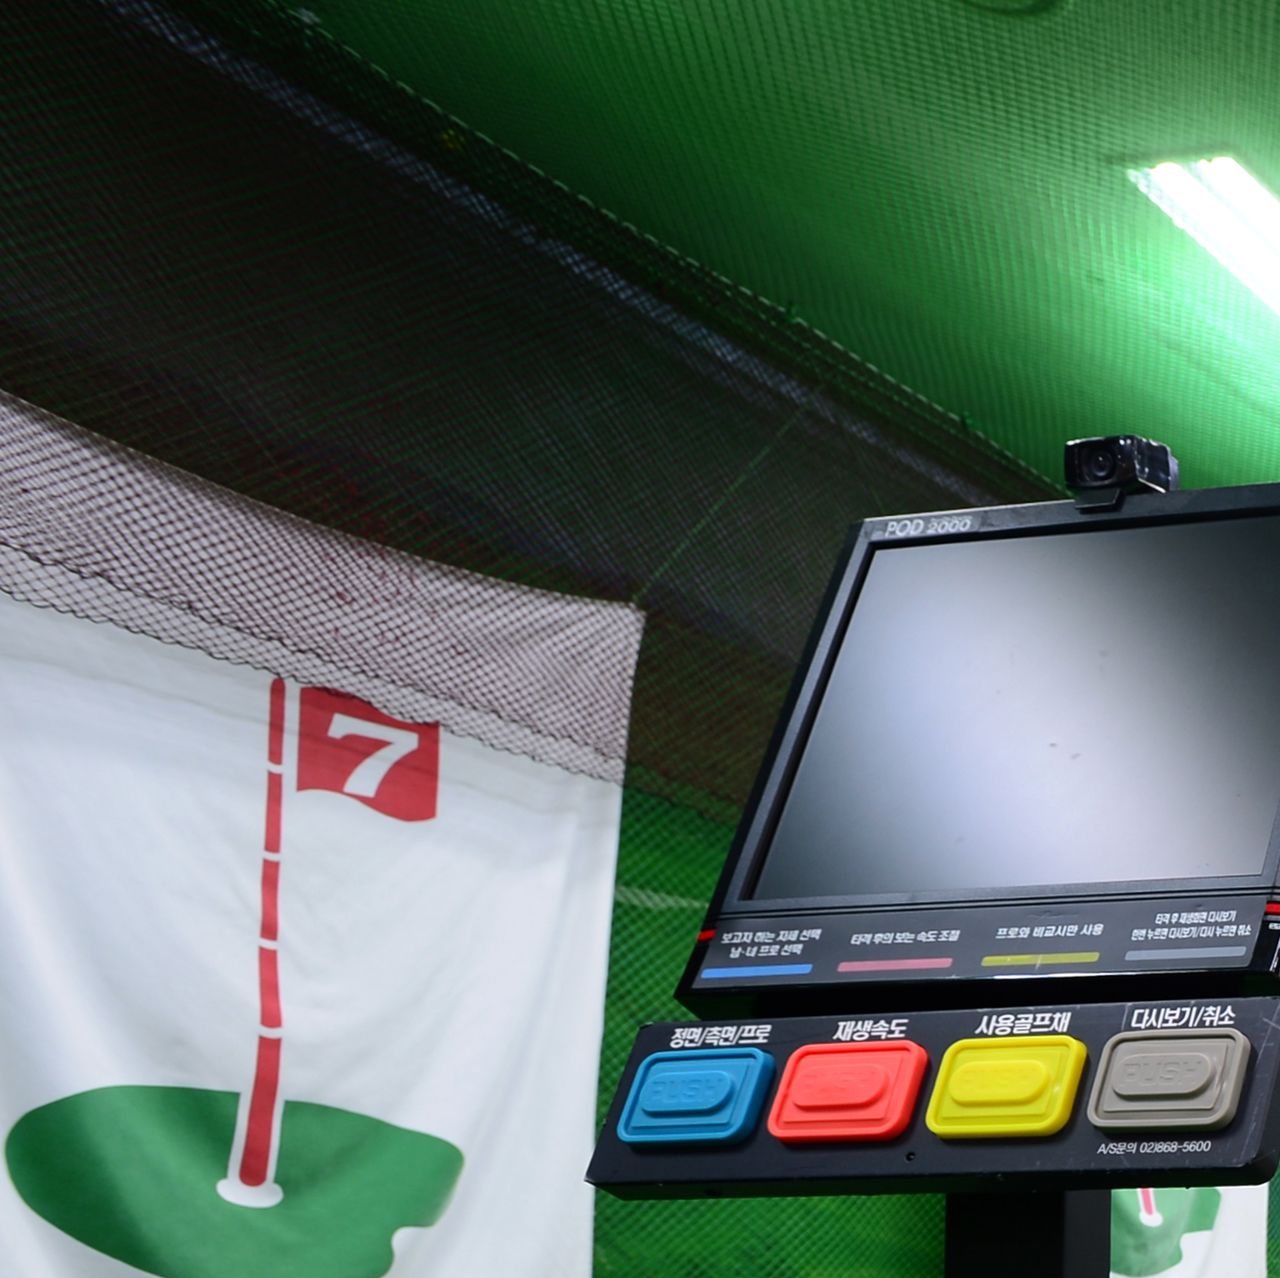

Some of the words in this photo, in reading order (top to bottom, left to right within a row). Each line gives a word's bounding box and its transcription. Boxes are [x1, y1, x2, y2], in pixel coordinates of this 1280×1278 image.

[885, 519, 924, 538] POD
[926, 518, 971, 535] 2000
[327, 713, 419, 799] 7
[721, 932, 754, 944] 보고자
[799, 928, 822, 941] 선택
[916, 930, 938, 943] 속도
[995, 926, 1030, 939] 프로와
[1032, 924, 1079, 938] 비교시만
[1080, 923, 1104, 936] 사용
[757, 944, 780, 957] 프로
[780, 943, 804, 956] 선택
[974, 1011, 1072, 1036] 사용골프채
[1130, 1005, 1236, 1029] 다시보기/취소
[669, 1024, 772, 1049] 정면/측면/프로
[832, 1018, 909, 1041] 재생속도
[1120, 1061, 1203, 1087] PUSH
[651, 1078, 725, 1103] PUSH
[1096, 1142, 1138, 1155] A/S문의
[1139, 1140, 1212, 1153] 02)868-5600
